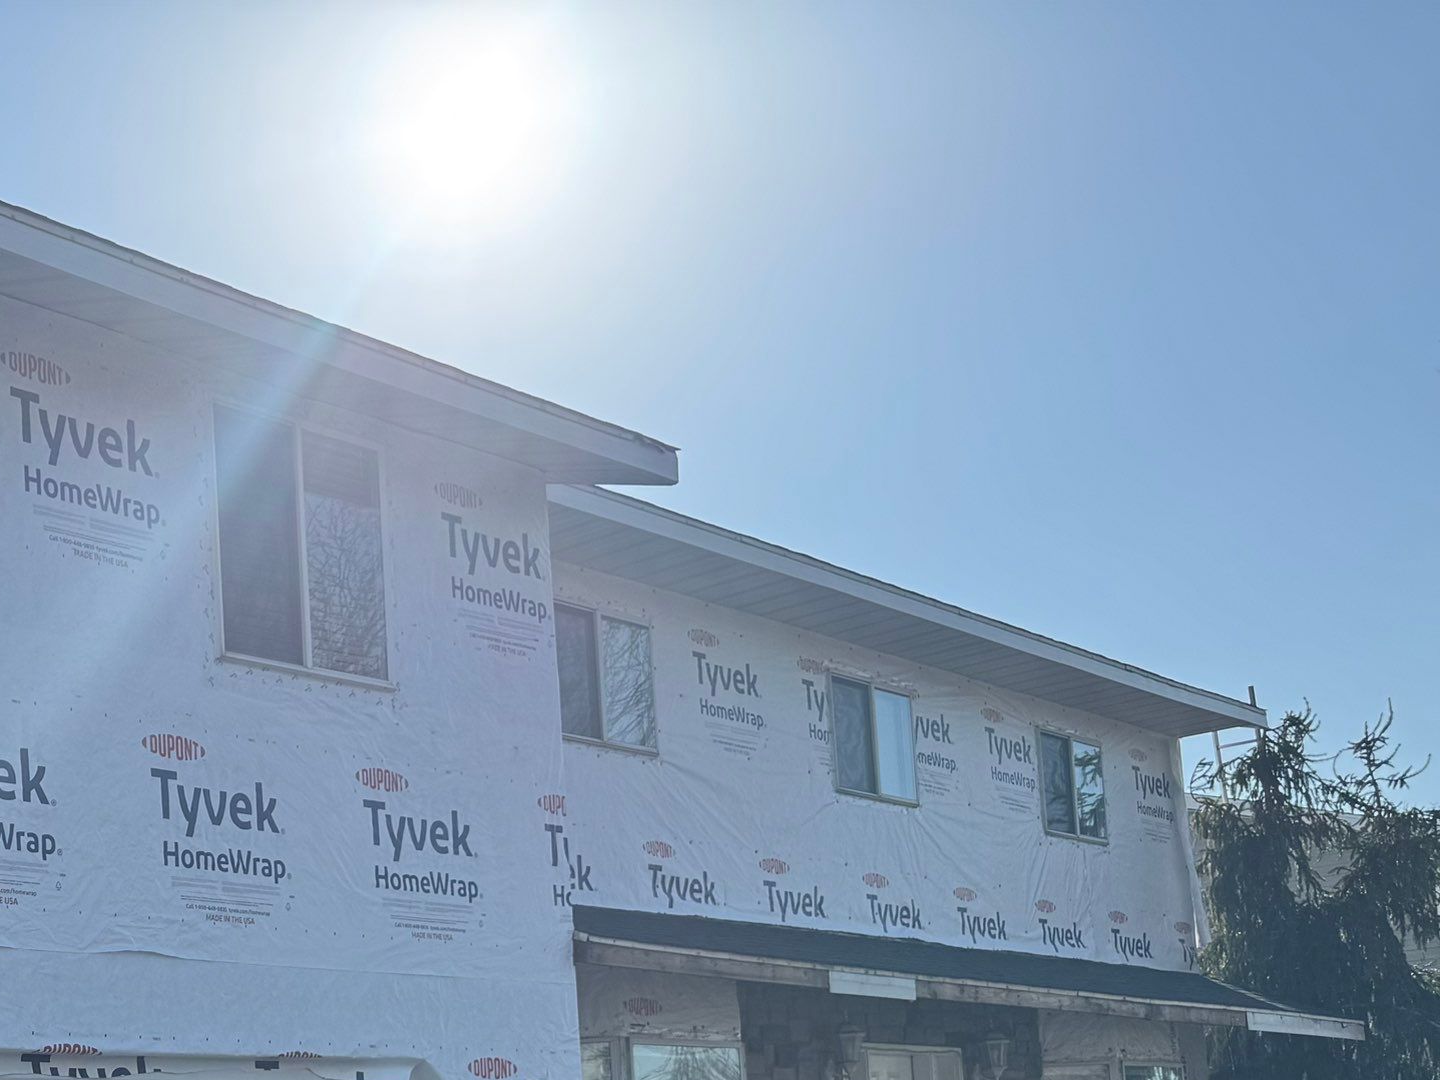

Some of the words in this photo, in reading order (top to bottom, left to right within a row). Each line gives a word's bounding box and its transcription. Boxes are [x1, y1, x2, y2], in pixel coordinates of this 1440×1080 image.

[10, 352, 63, 386] DUPONT
[10, 386, 153, 477] Tyvek
[24, 465, 160, 528] HomeWrap
[440, 483, 477, 509] DUPONT
[441, 512, 541, 579] Tyvek
[451, 576, 546, 623] HomeWrap
[692, 651, 759, 697] Tyvek
[700, 698, 764, 730] HomeWrap
[150, 734, 198, 760] DUPONT
[917, 752, 956, 773] meWrap
[984, 726, 1032, 764] Tyvek
[362, 768, 403, 792] DUPONT
[991, 765, 1036, 792] HomeWrap
[1132, 766, 1170, 799] Tyvek
[150, 768, 280, 837] Tyvek
[363, 800, 473, 861] Tyvek
[163, 841, 286, 884] HomeWrap
[4, 896, 18, 905] USA
[375, 865, 478, 903] HomeWrap
[648, 864, 716, 908] Tyvek
[763, 880, 826, 922] Tyvek
[866, 894, 921, 933] Tyvek
[958, 907, 1007, 943] Tyvek
[1039, 918, 1086, 952] Tyvek
[1111, 928, 1153, 961] Tyvek
[474, 1057, 512, 1080] DUPONT
